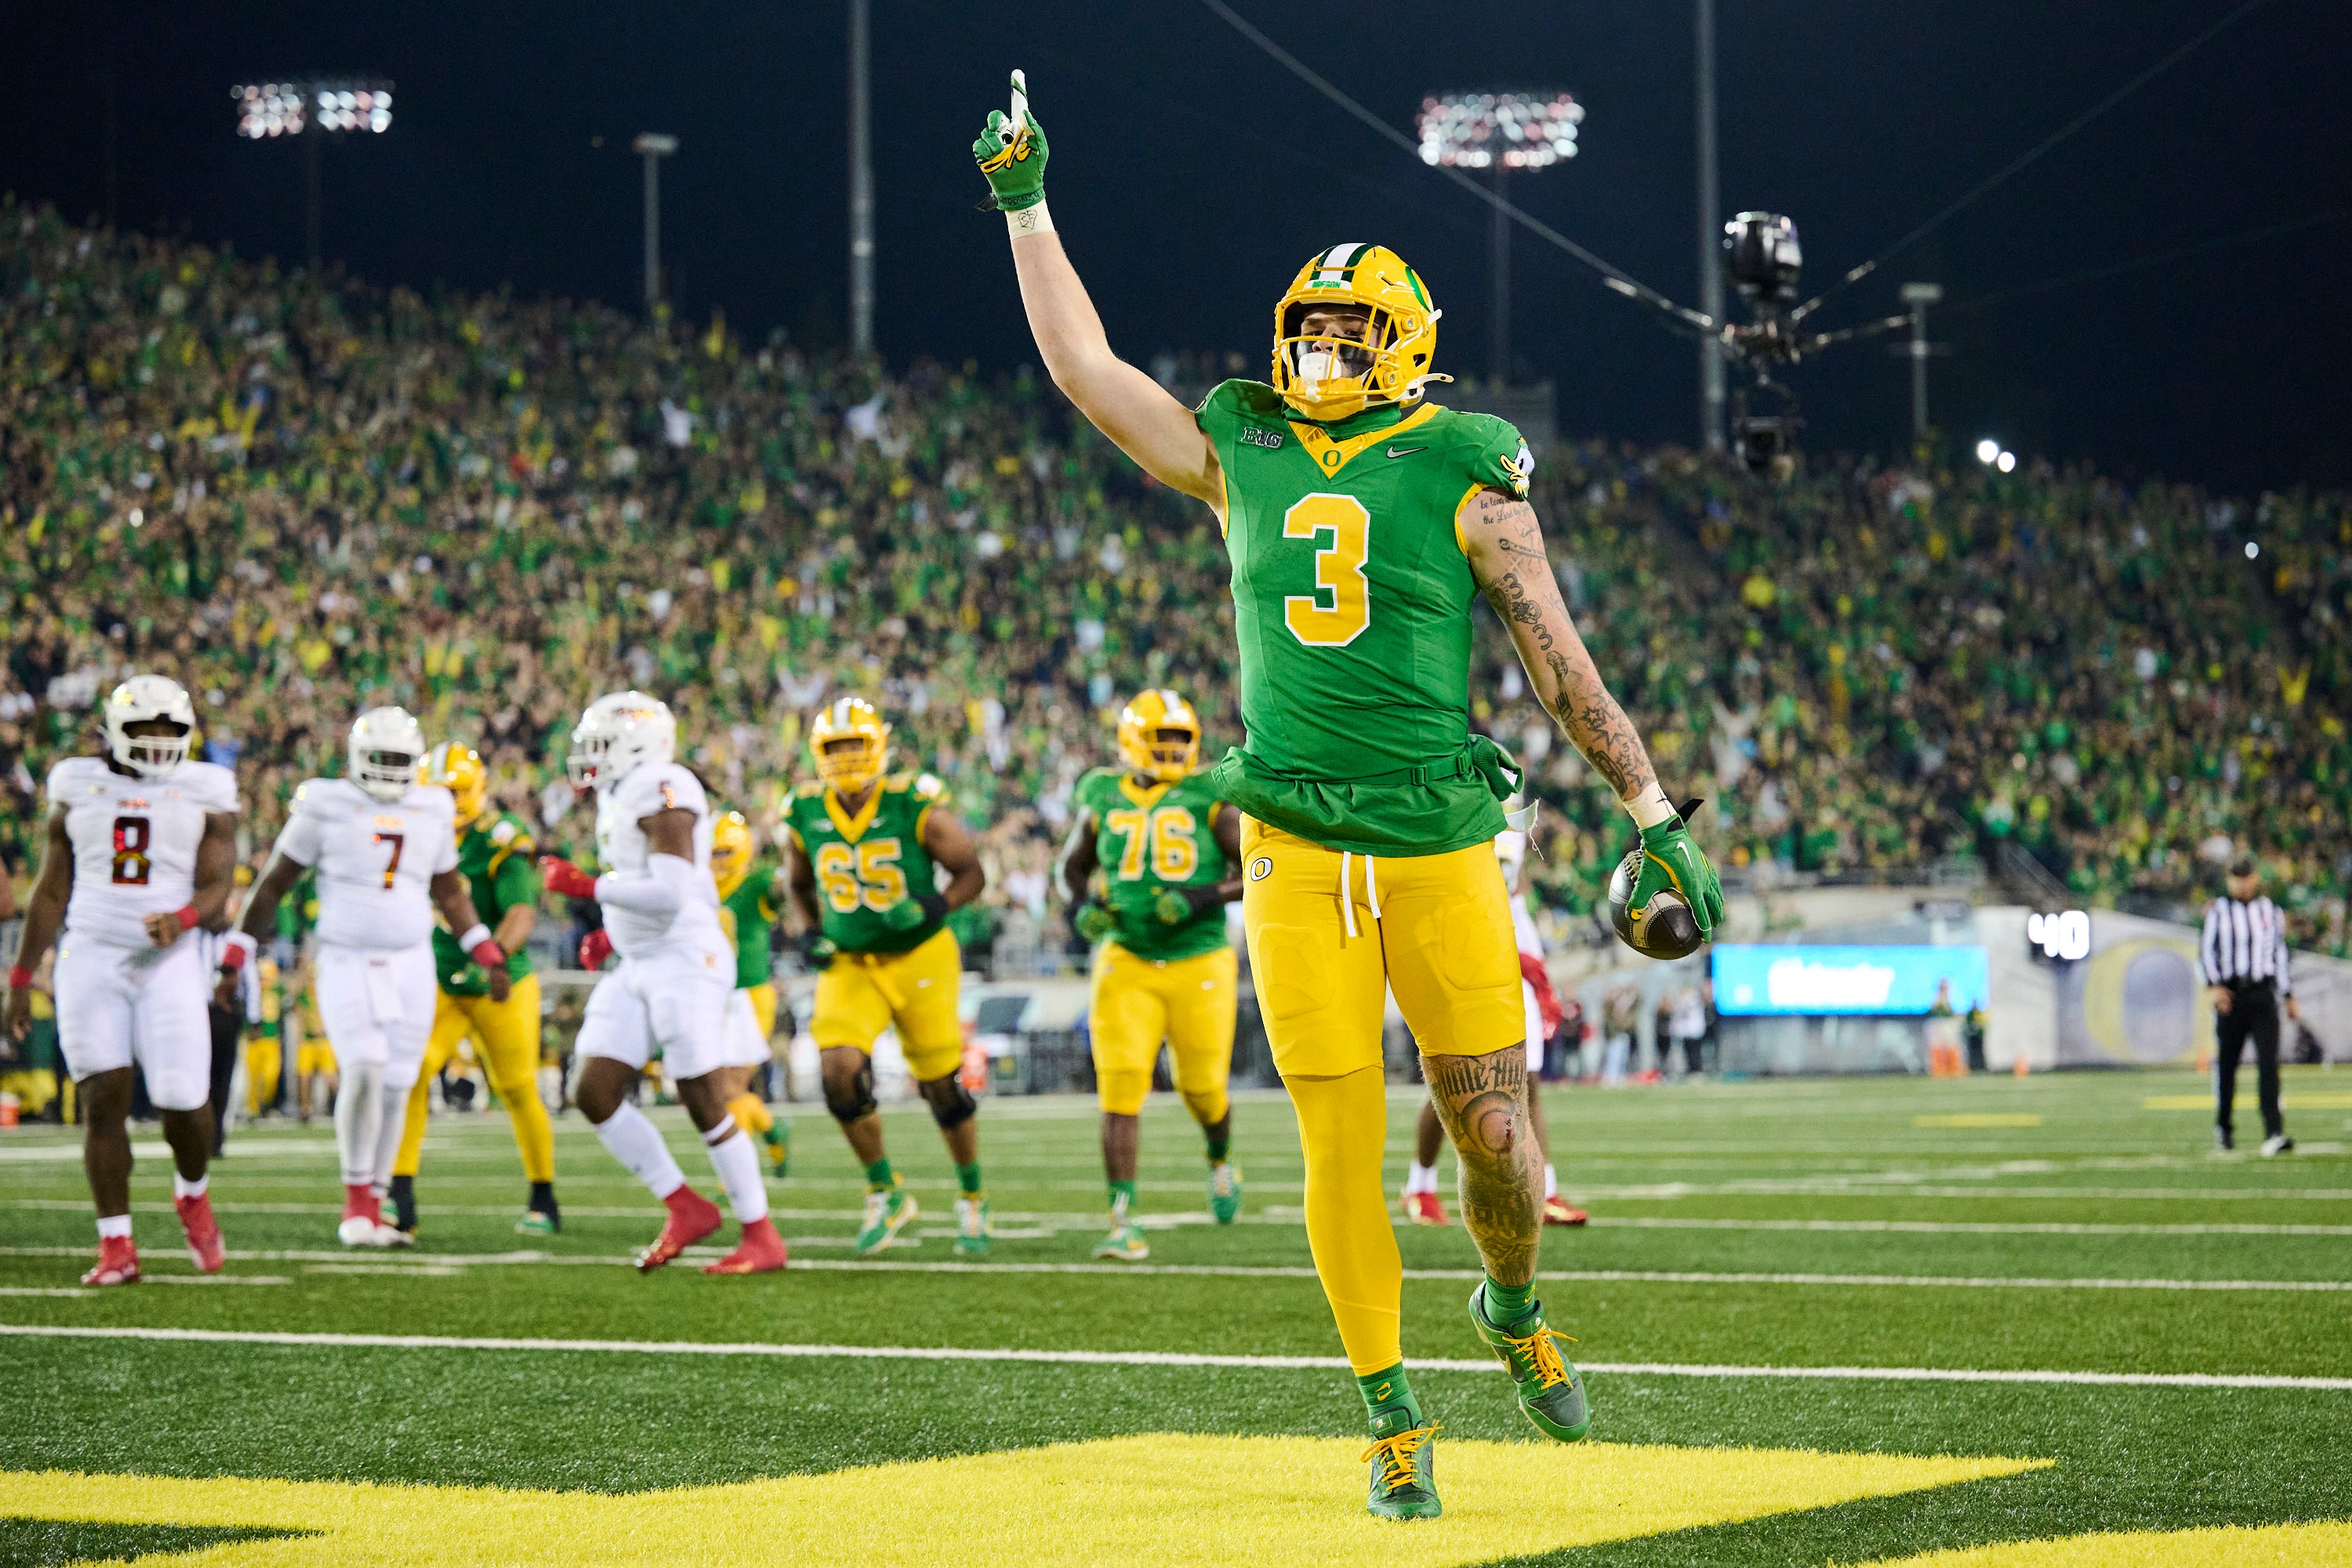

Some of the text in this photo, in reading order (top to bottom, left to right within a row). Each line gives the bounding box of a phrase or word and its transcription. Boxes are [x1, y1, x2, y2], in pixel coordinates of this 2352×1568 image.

[1323, 450, 1341, 466] O
[1283, 492, 1370, 647] 3
[113, 817, 150, 884] 8
[372, 834, 403, 889] 7
[1106, 806, 1199, 881] 76
[1250, 857, 1272, 881] O
[815, 837, 907, 913] 65
[2028, 910, 2090, 960] 40
[1489, 1051, 1526, 1094] Hig
